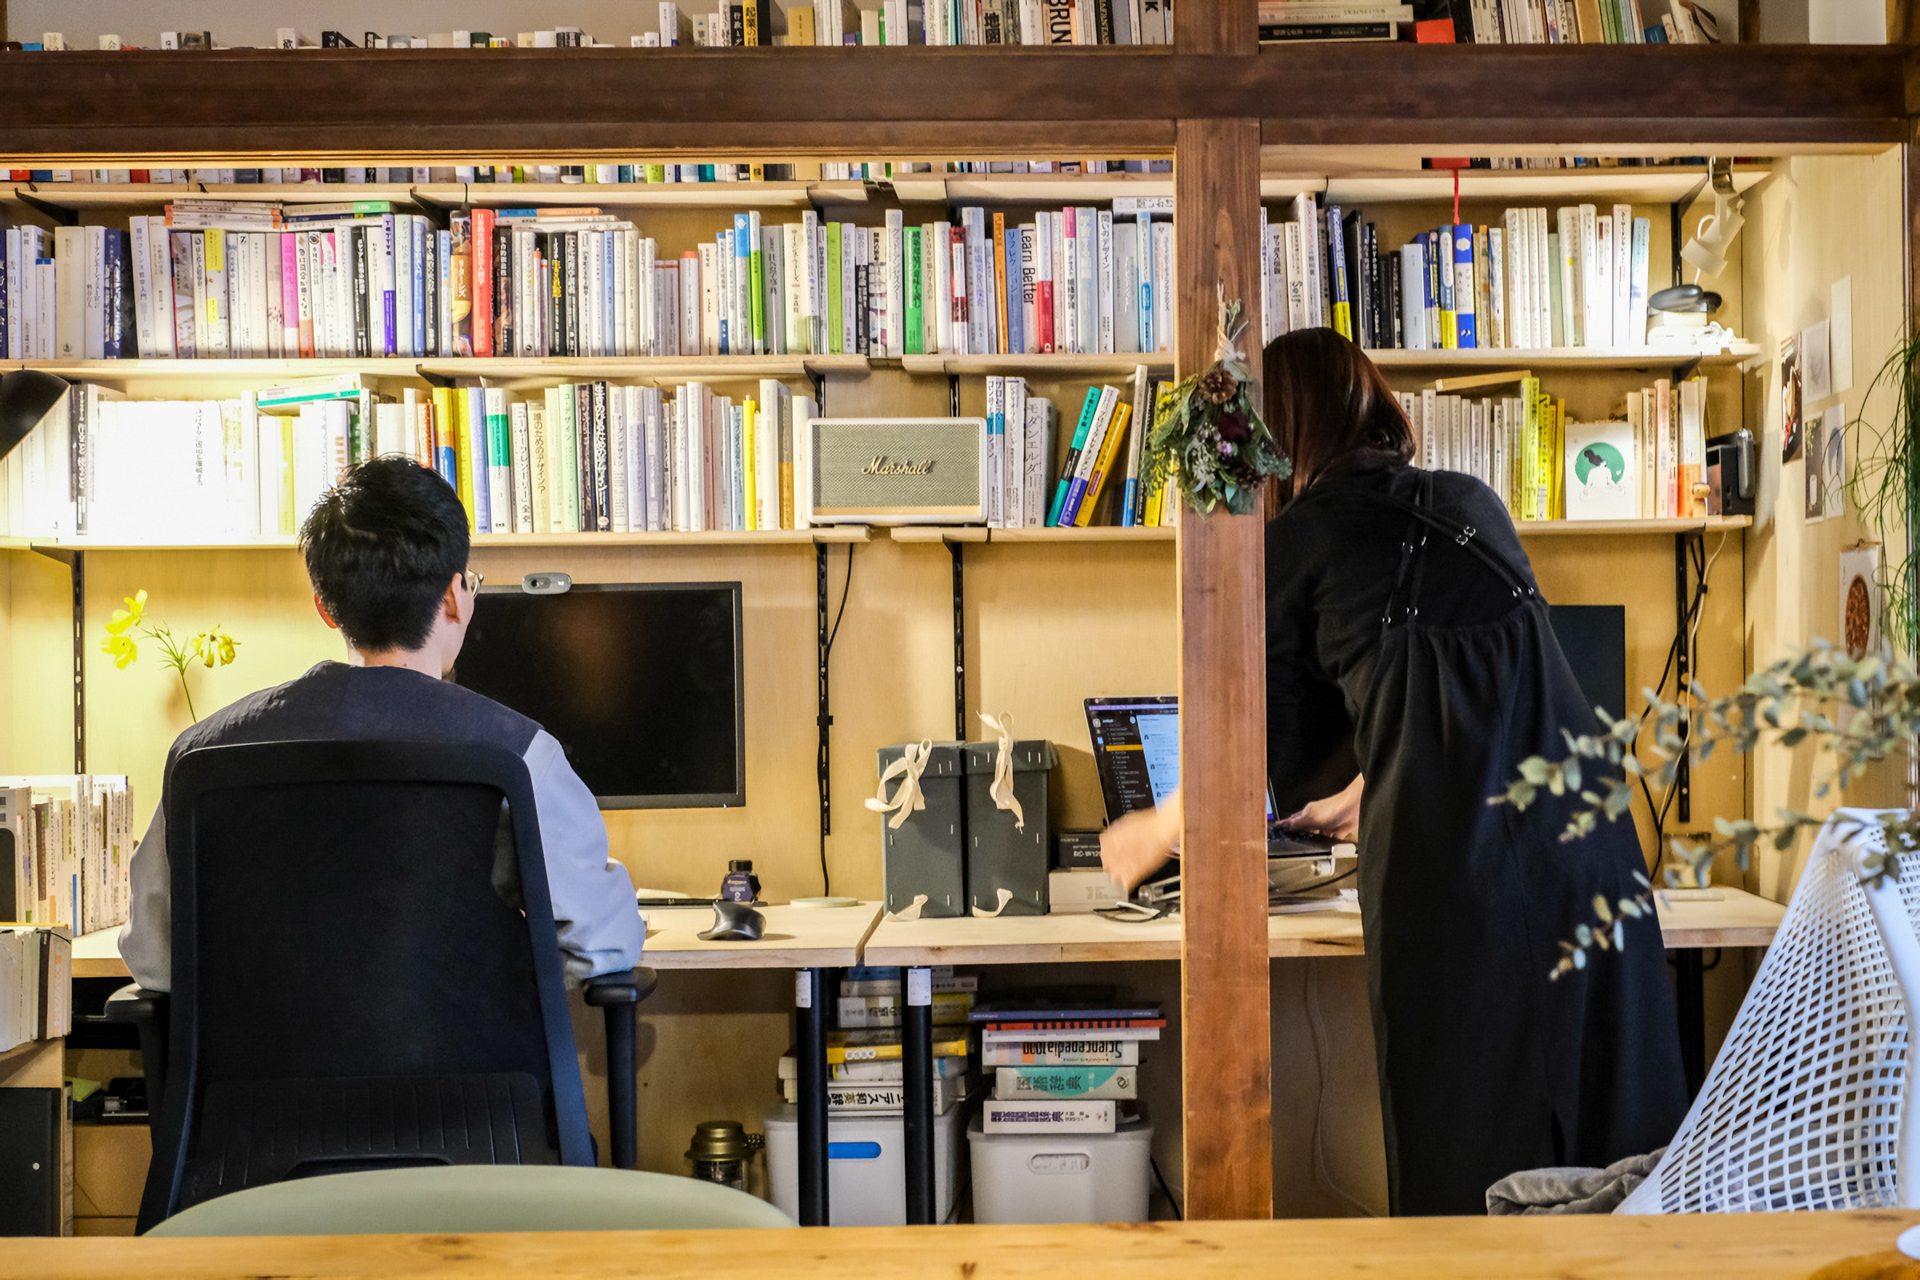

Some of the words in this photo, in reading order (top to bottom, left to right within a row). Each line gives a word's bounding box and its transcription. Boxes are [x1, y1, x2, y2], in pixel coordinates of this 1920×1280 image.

[1008, 230, 1018, 294] リフレクション
[1022, 228, 1034, 263] Learn
[458, 259, 467, 298] リターンズ
[1022, 267, 1037, 306] Better
[1291, 281, 1303, 307] Self-
[1026, 403, 1040, 488] モダンエルダー
[862, 456, 934, 475] Marshall
[828, 1092, 904, 1106] ニアス和英辞
[1016, 1076, 1082, 1091] 国語辞典
